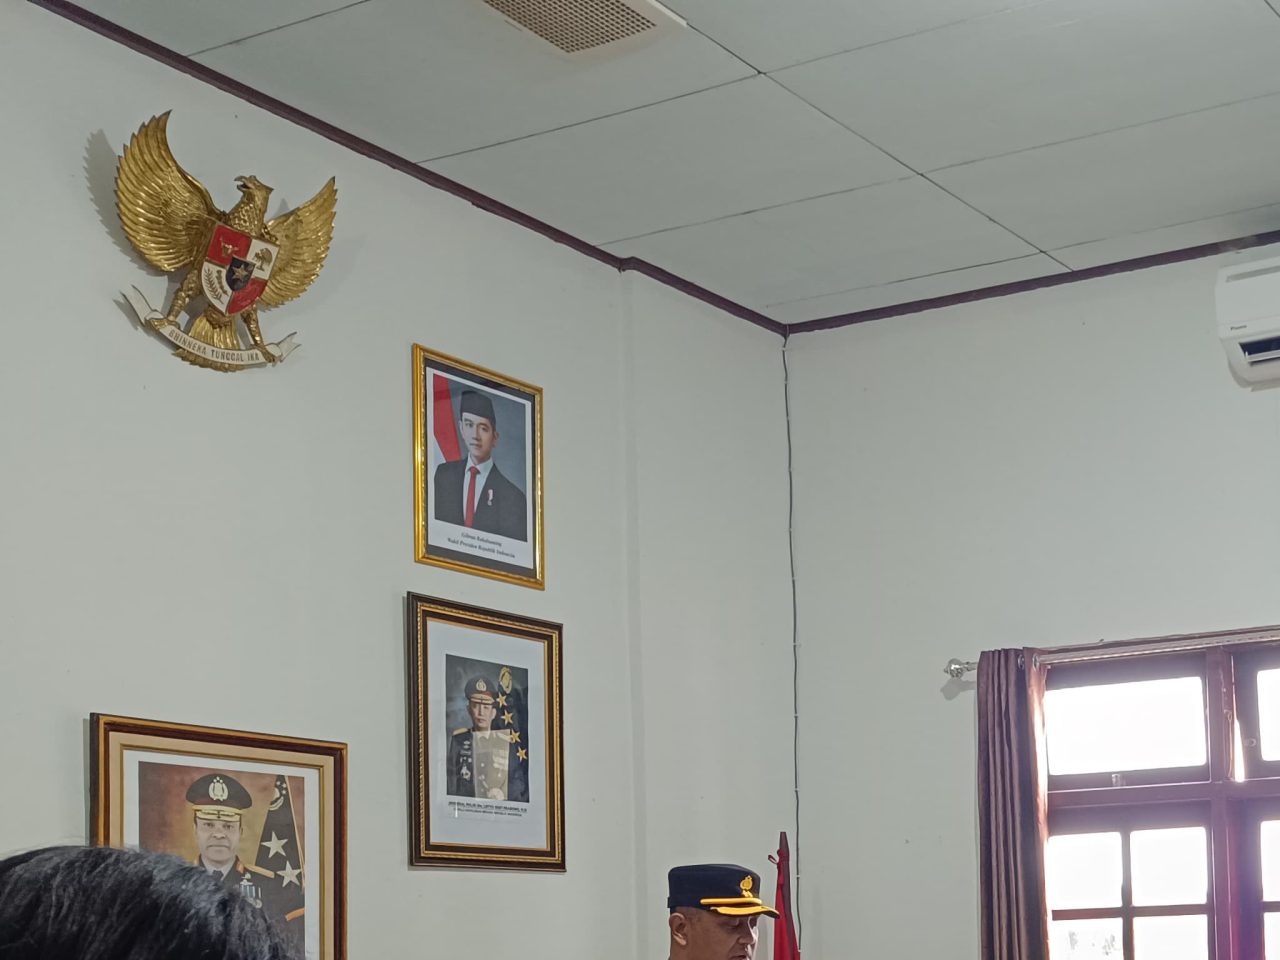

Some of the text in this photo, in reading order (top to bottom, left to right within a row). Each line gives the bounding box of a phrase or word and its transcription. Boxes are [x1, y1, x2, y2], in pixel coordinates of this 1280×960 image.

[168, 329, 260, 362] BHINNEKA TUNGGAL IKA
